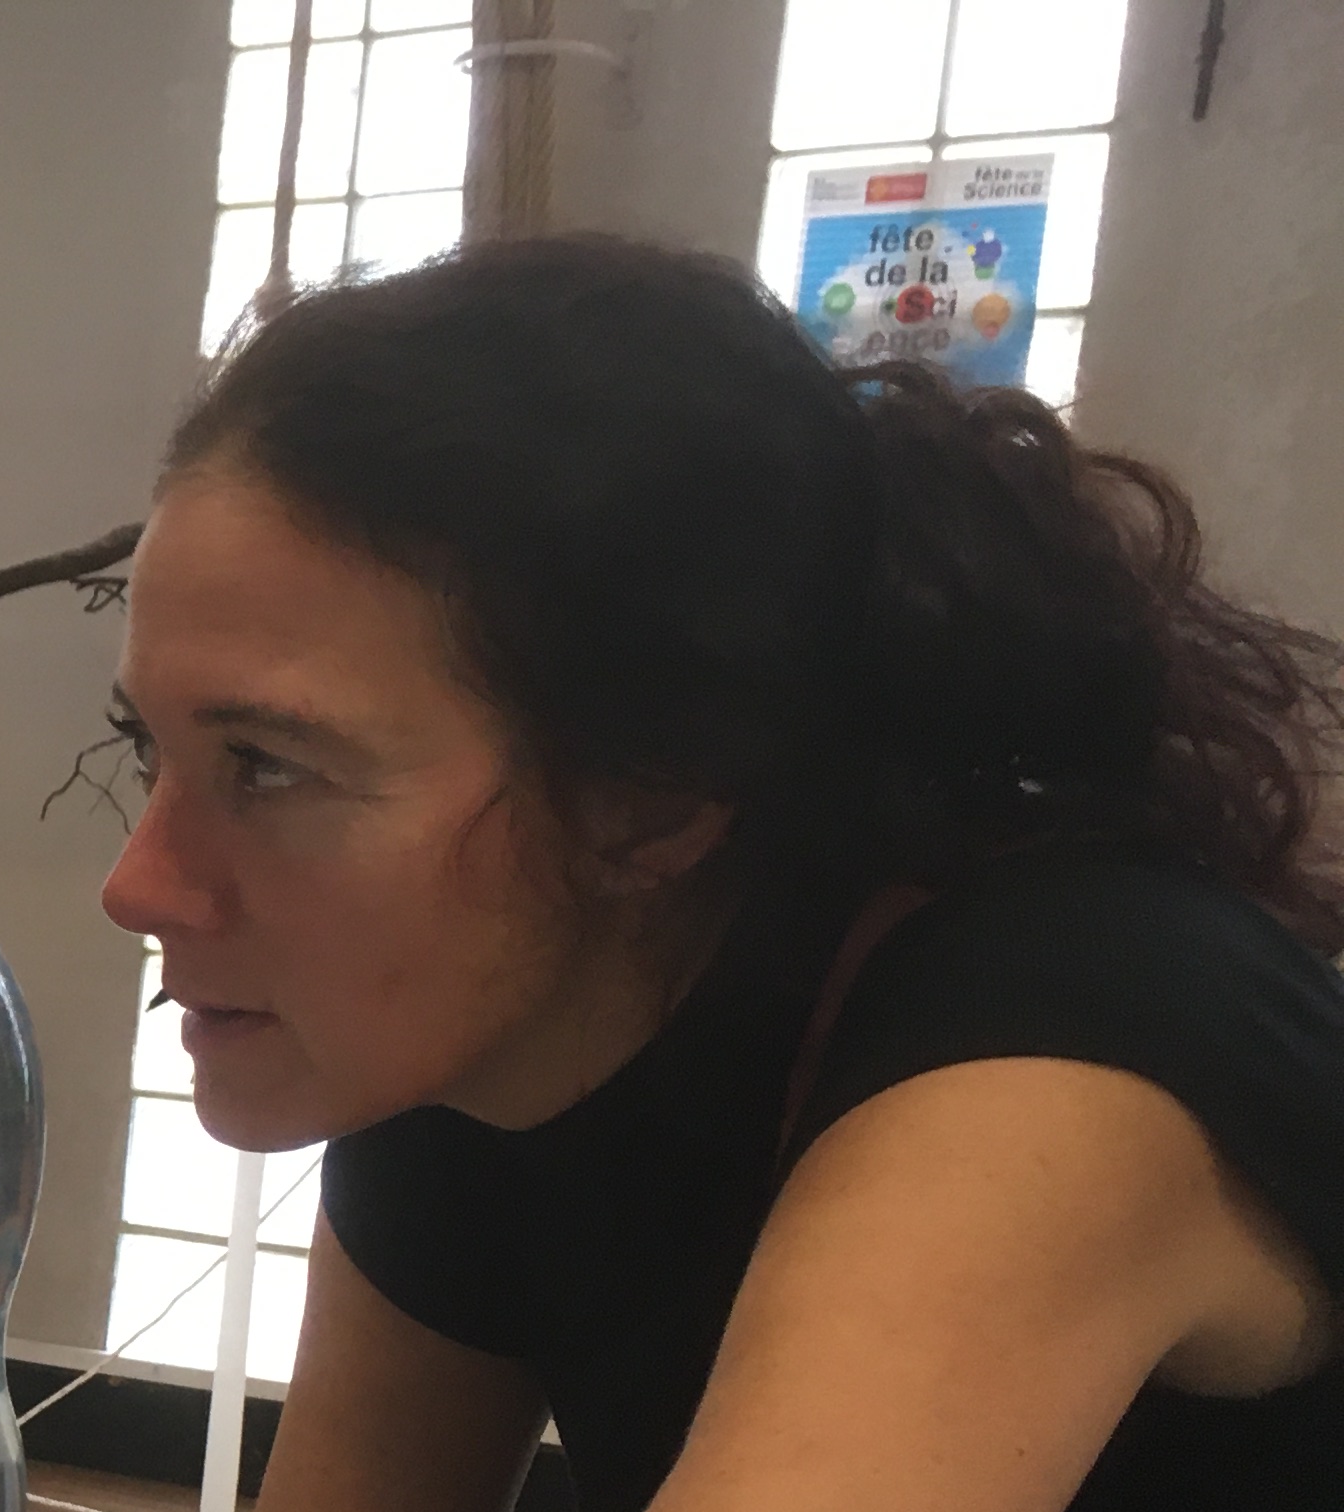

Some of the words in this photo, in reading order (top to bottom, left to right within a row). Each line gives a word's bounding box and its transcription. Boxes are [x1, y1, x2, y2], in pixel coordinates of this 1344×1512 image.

[868, 223, 935, 254] fête
[865, 257, 907, 287] de
[919, 255, 949, 286] la
